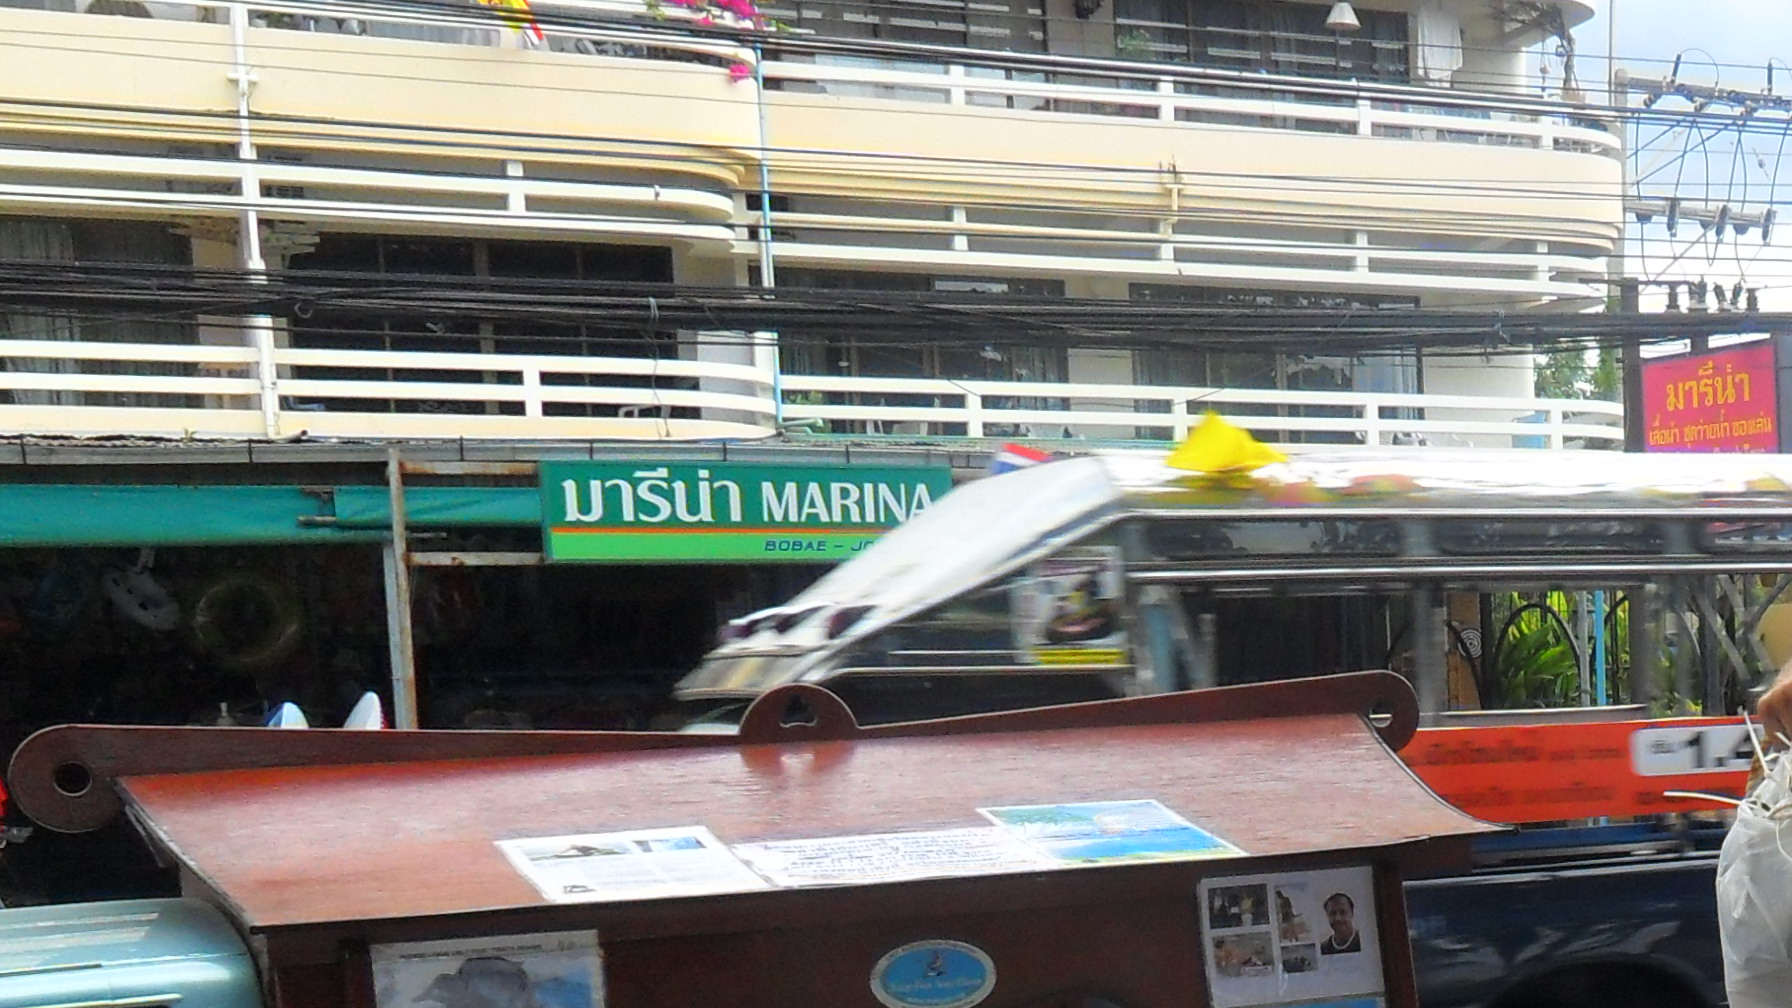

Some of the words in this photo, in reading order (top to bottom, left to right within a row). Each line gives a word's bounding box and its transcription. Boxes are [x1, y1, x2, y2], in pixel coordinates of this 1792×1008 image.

[1666, 360, 1749, 411] มารีน่า
[562, 467, 742, 522] มารีน่า
[762, 482, 932, 523] MARINA
[764, 540, 827, 552] BOBAE
